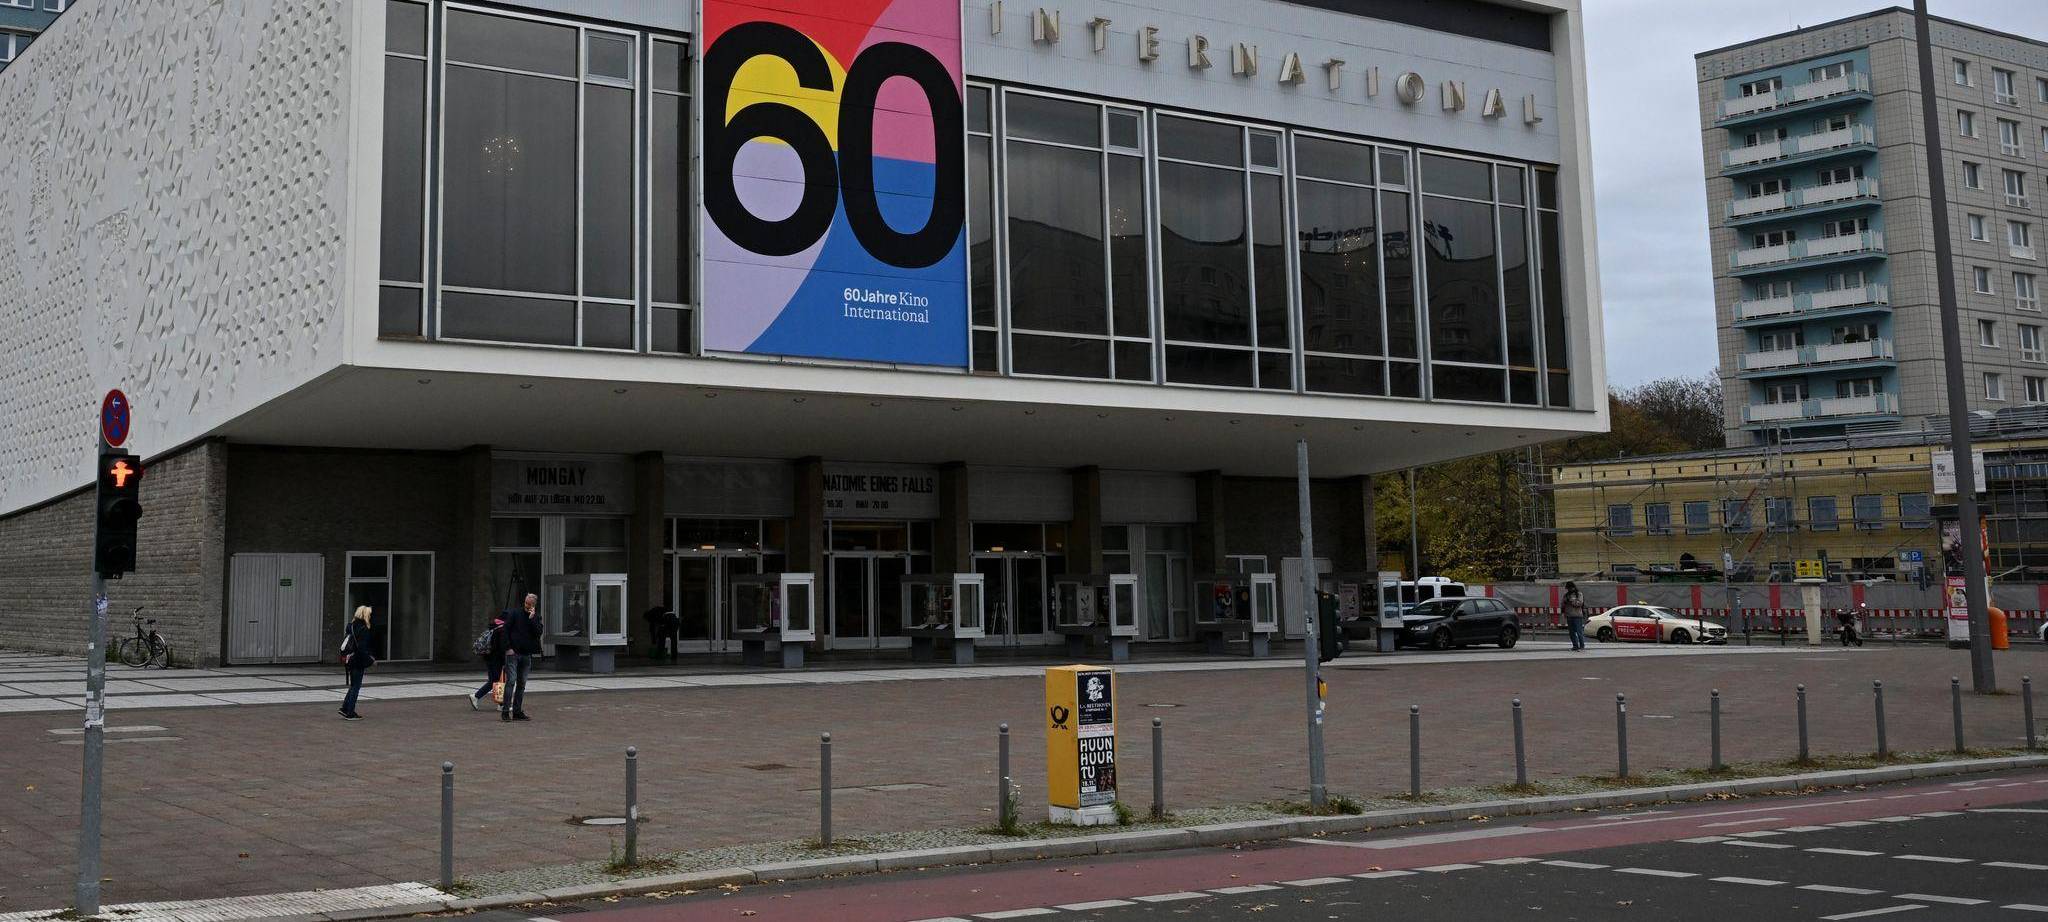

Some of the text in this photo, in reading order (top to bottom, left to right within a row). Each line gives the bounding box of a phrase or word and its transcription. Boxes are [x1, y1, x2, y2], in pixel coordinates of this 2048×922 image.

[990, 0, 1543, 127] INTERNATIONAL
[703, 21, 966, 269] 60
[899, 292, 928, 307] Kino
[844, 303, 929, 323] International
[527, 467, 586, 486] MONGAY
[823, 474, 933, 494] NATOMIE EINES FALLS
[1080, 737, 1113, 753] HUUN
[1080, 751, 1114, 766] HUUR
[1080, 766, 1095, 779] TU
